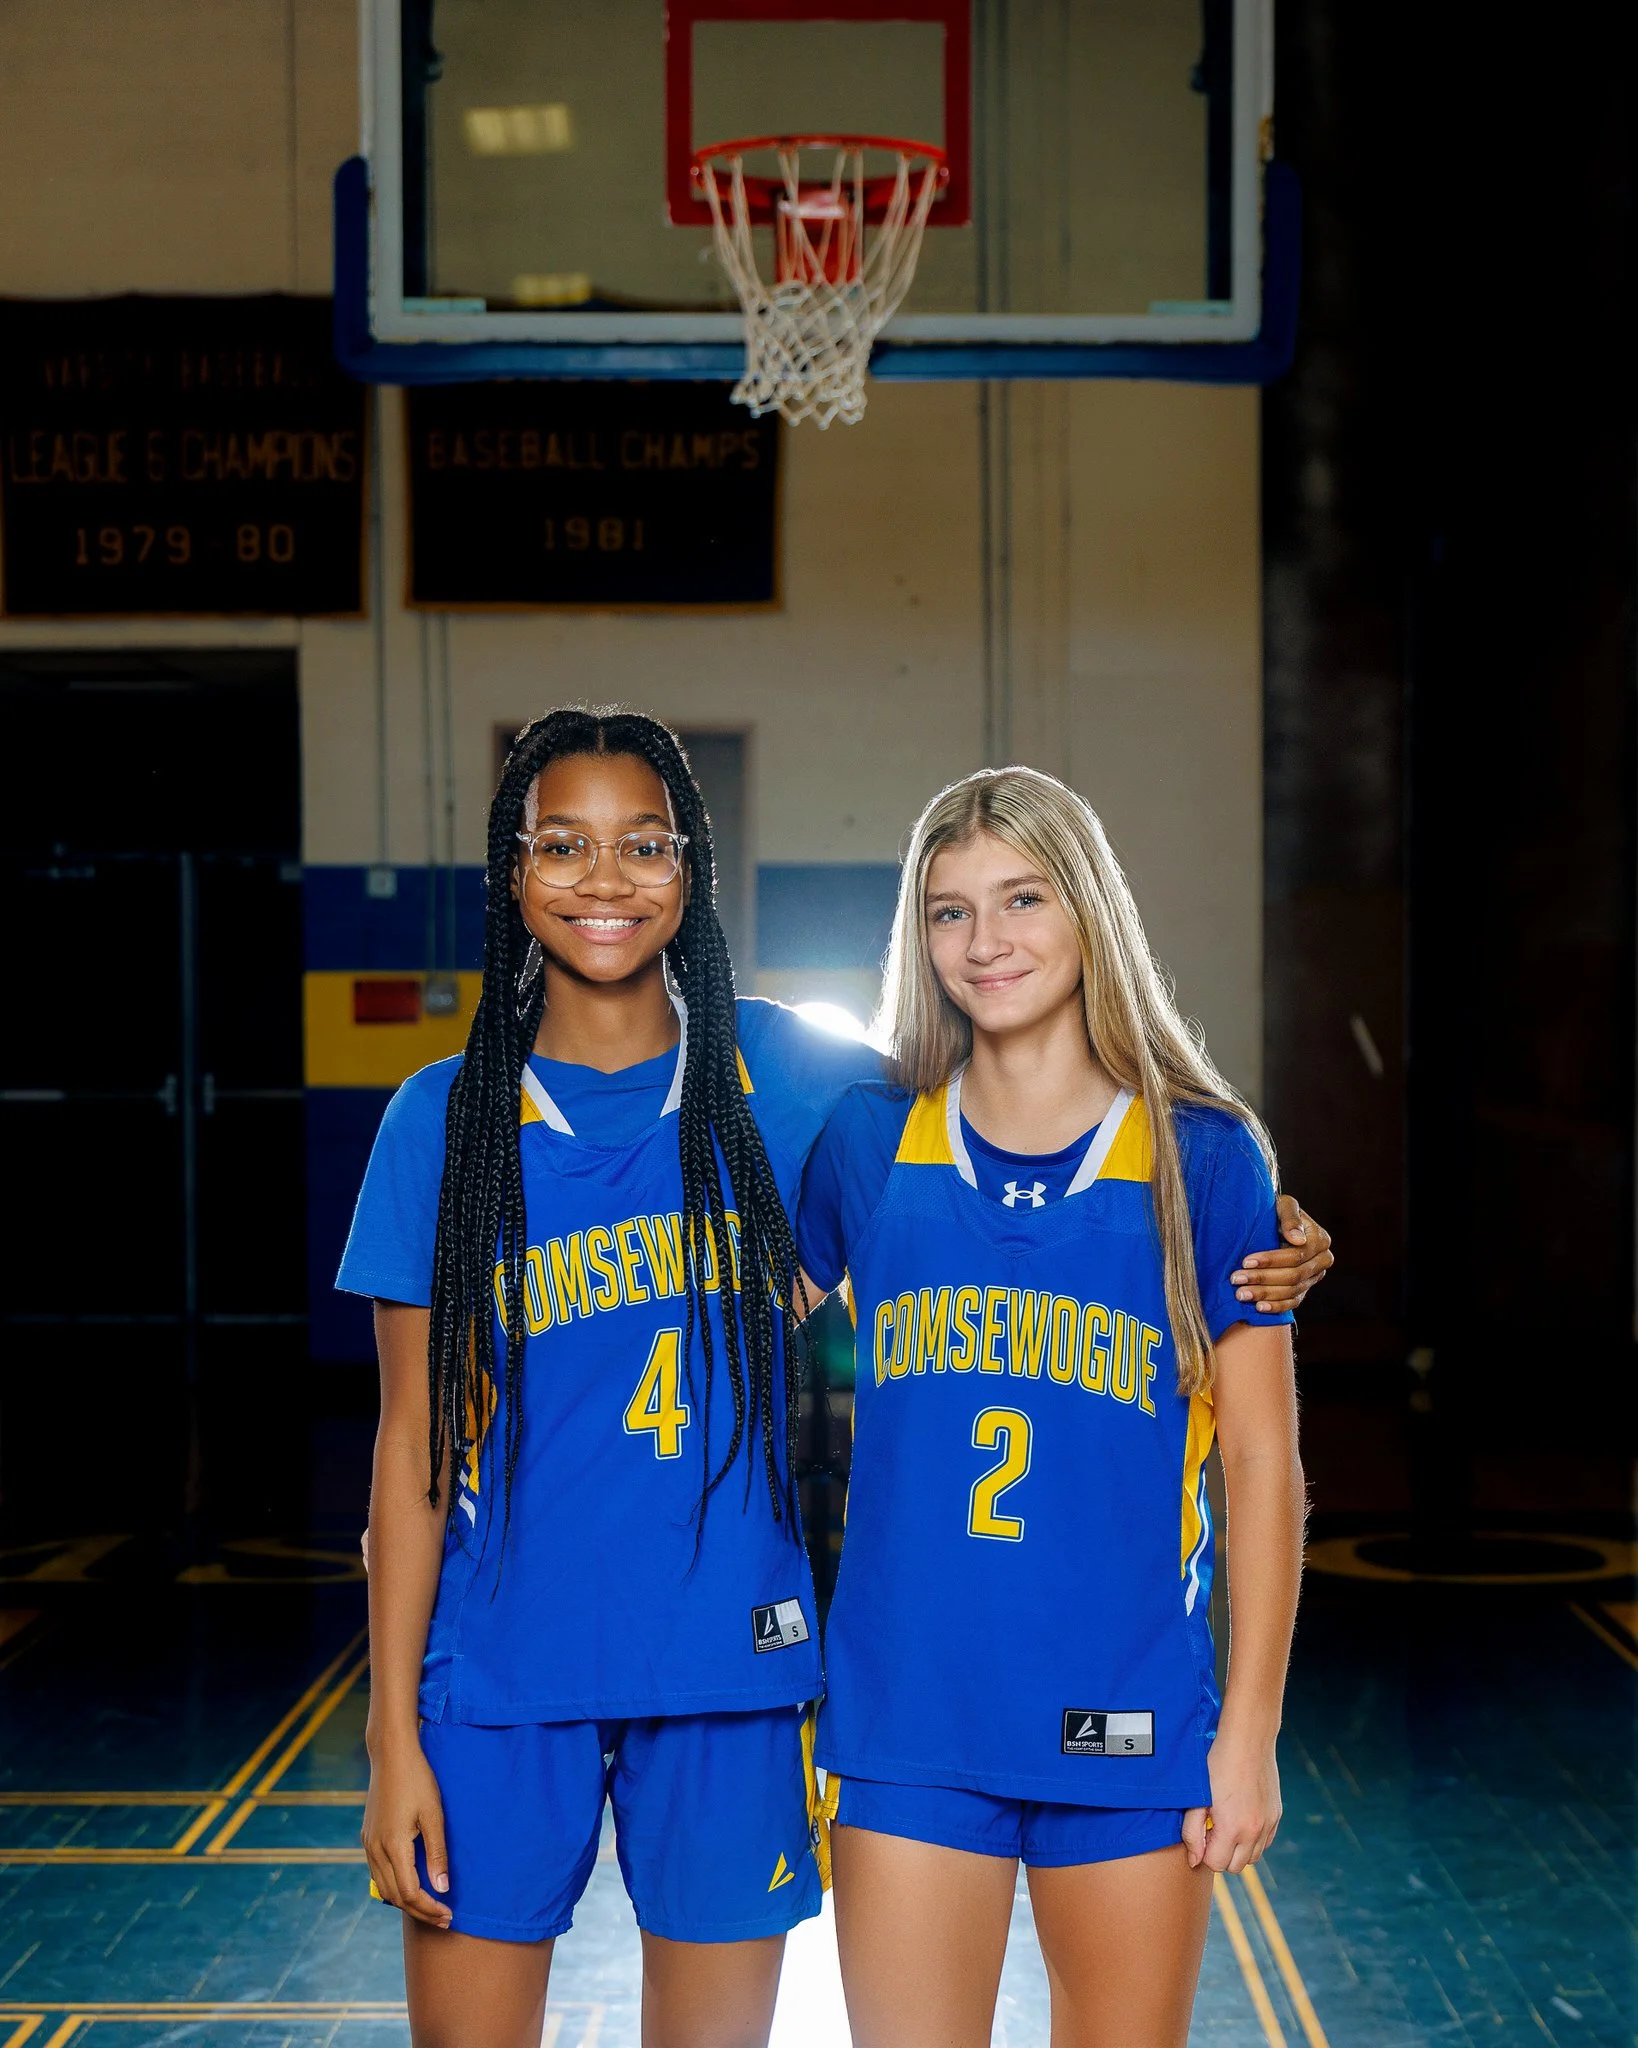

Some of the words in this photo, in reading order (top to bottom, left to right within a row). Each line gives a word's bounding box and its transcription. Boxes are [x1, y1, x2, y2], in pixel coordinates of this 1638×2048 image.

[10, 430, 129, 485] LEAGUE
[181, 429, 356, 485] CHAMPIONS
[426, 428, 608, 471] BASEBALL
[619, 429, 762, 471] CHAMPS
[873, 1285, 1162, 1418] COMSEWOGUE
[623, 1328, 690, 1459] 4
[967, 1405, 1033, 1542] 2
[792, 1626, 799, 1637] S
[1125, 1738, 1134, 1750] S
